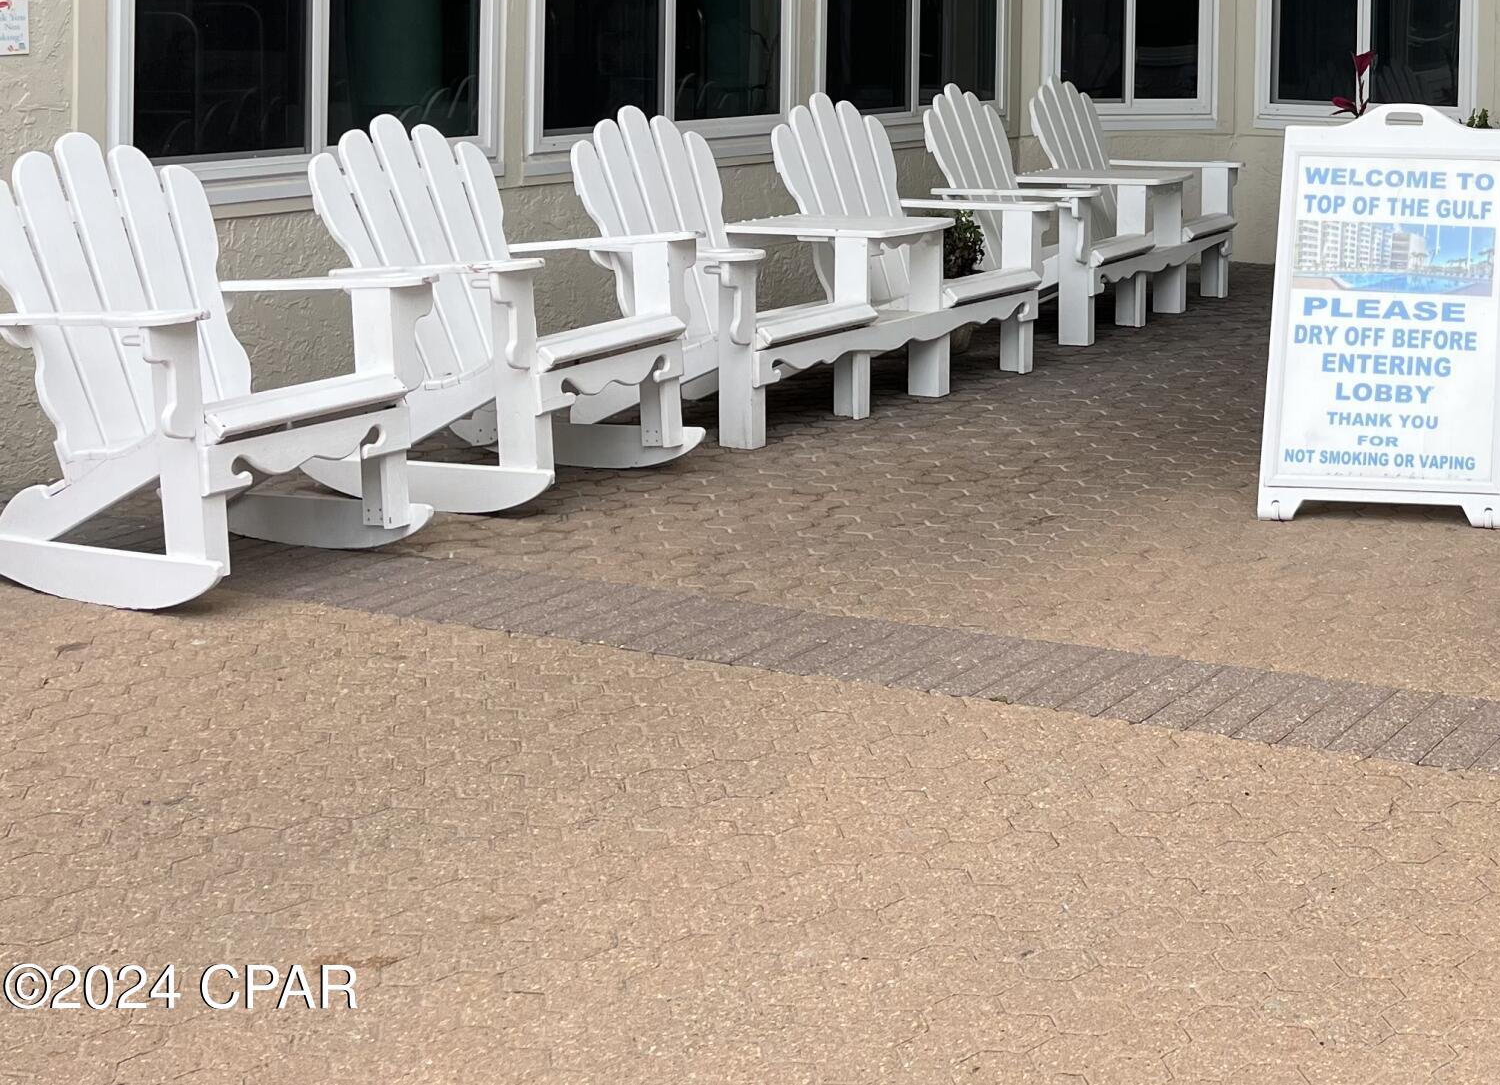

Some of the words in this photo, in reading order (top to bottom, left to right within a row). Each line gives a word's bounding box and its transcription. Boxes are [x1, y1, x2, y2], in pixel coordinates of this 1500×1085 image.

[1305, 167, 1447, 189] WELCOME
[1456, 172, 1495, 191] TO
[1304, 194, 1346, 214] TOP
[1352, 196, 1380, 215] OF
[1387, 197, 1429, 217] THE
[1436, 200, 1492, 220] GULF
[1303, 297, 1466, 322] PLEASE
[1294, 324, 1338, 345] DRY
[1344, 326, 1385, 347] OFF
[1392, 328, 1477, 351] BEFORE
[1321, 353, 1451, 377] ENTERING
[1335, 382, 1434, 404] LOBBY
[1327, 411, 1392, 428] THANK
[1399, 415, 1439, 430] YOU
[1357, 435, 1399, 447] FOR
[1284, 449, 1315, 464] NOT
[1319, 450, 1389, 467] SMOKING
[1394, 454, 1415, 468] OR
[1419, 454, 1476, 470] VAPING
